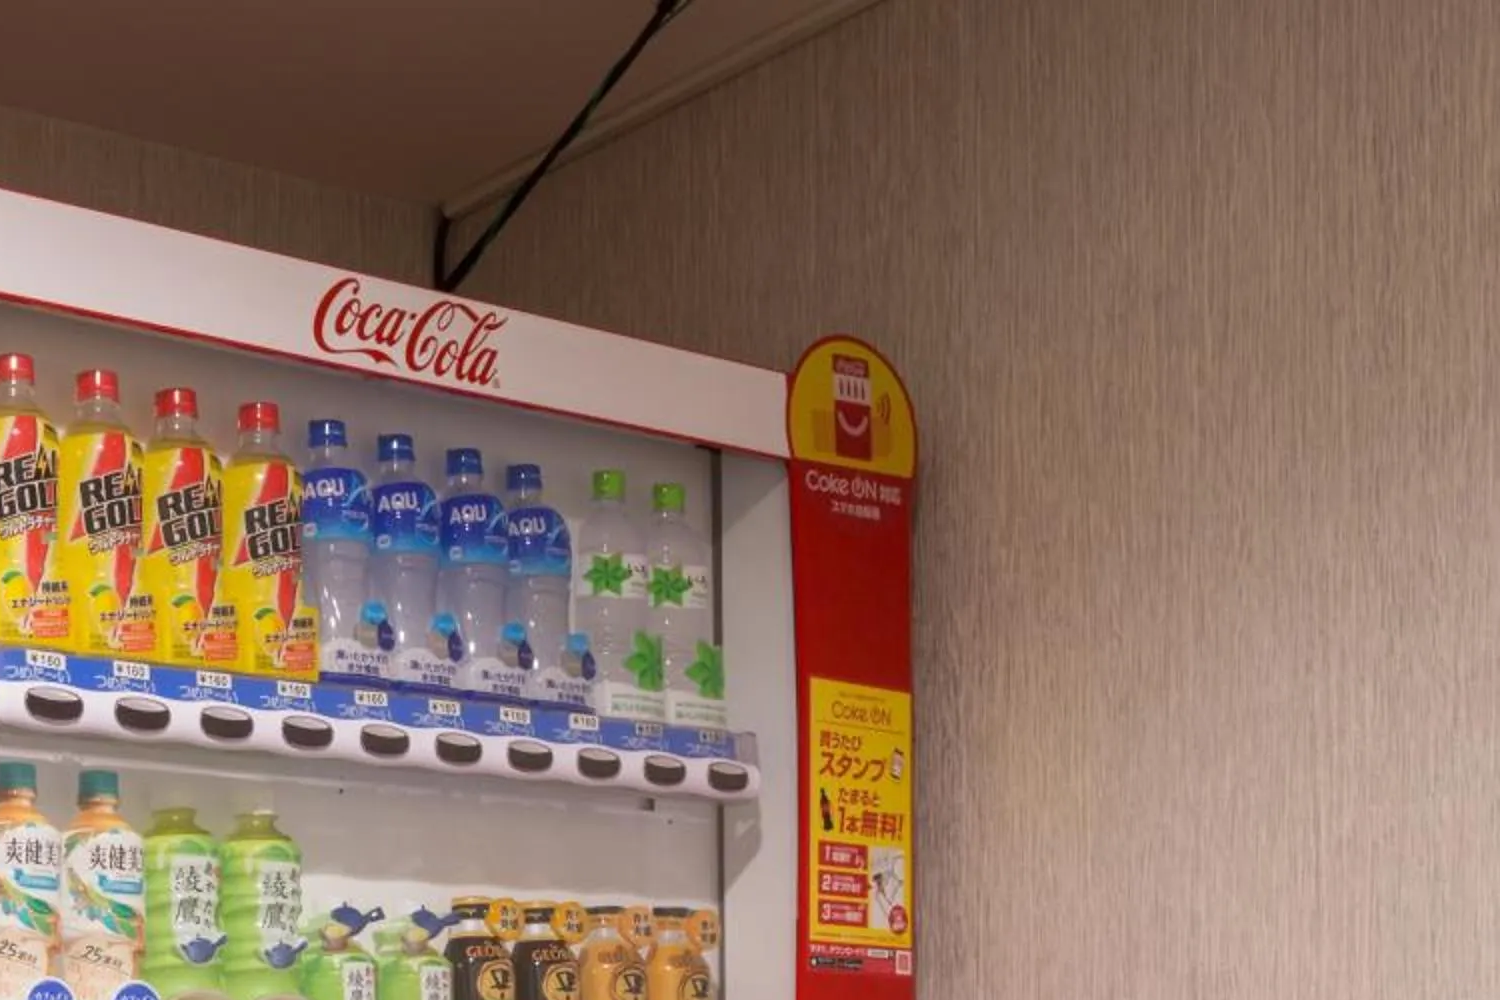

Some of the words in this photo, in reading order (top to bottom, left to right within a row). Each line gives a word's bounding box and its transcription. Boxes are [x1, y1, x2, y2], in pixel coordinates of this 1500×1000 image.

[313, 278, 509, 386] Coca-Cola
[84, 499, 142, 534] GOL
[162, 510, 221, 546] GOL
[249, 525, 301, 557] GOL
[819, 751, 886, 783] スタンプ
